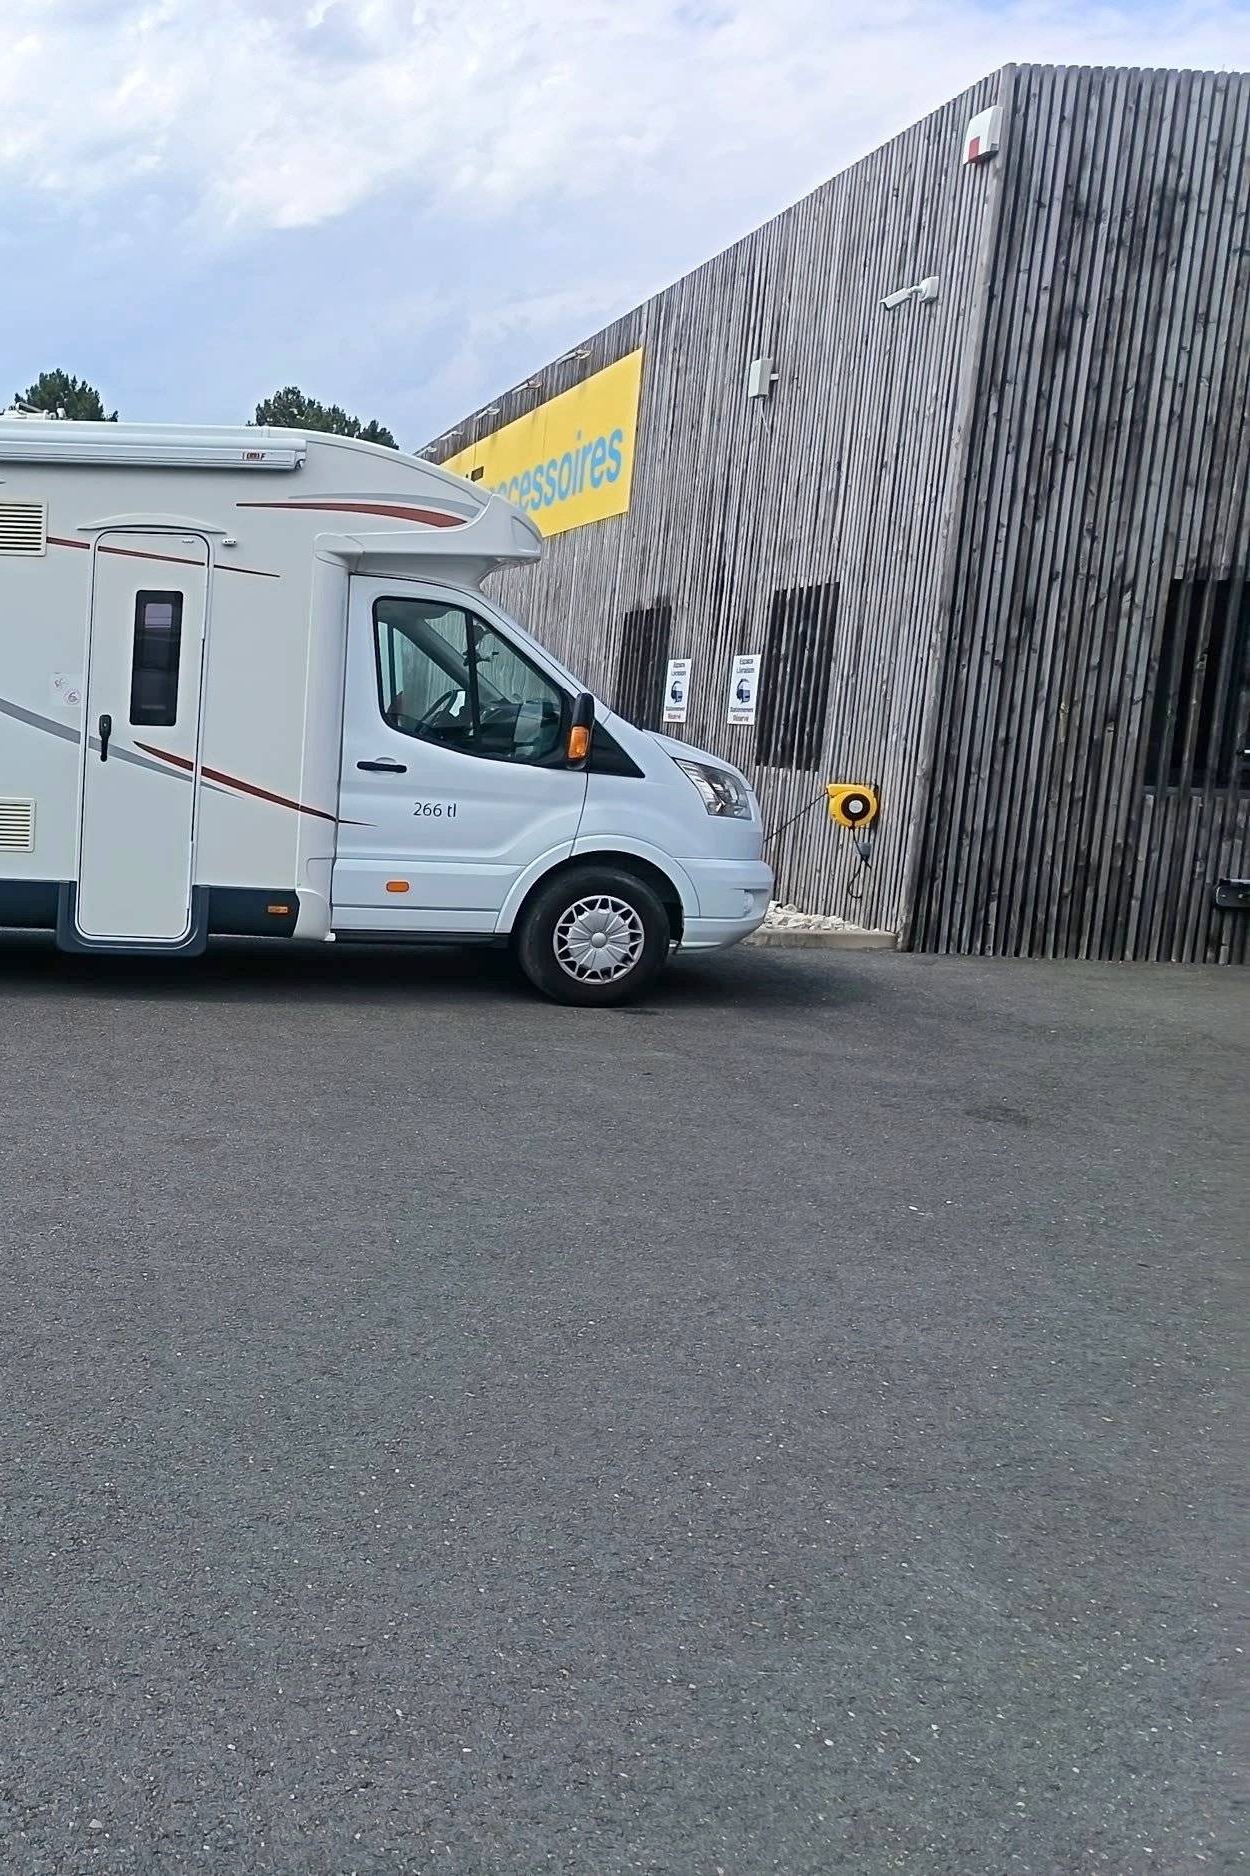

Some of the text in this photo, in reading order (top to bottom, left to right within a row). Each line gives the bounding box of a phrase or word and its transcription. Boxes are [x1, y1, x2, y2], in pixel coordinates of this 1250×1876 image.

[492, 428, 624, 512] cessoires
[413, 801, 457, 818] 266 tl
